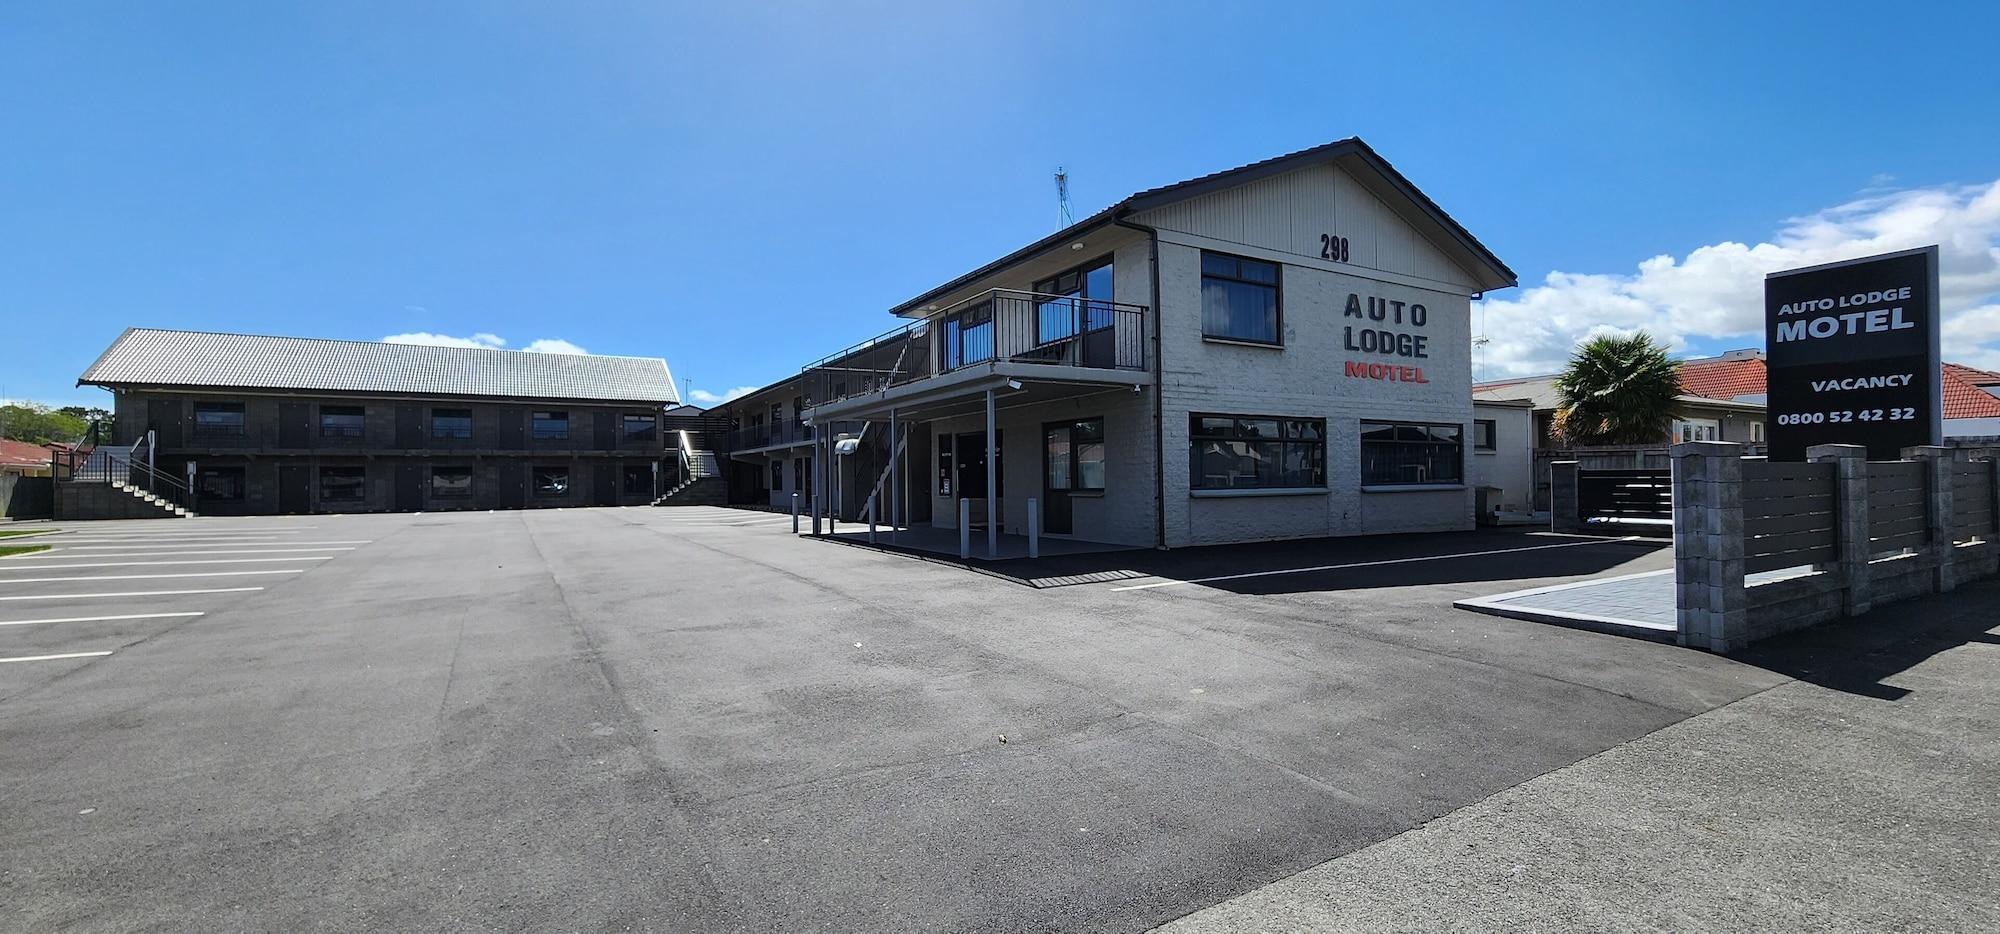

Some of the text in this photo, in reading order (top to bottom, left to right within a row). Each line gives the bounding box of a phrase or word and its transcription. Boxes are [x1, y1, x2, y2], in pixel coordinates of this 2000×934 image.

[1320, 233, 1349, 262] 298
[1344, 293, 1427, 327] AUTO
[1777, 286, 1912, 316] AUTO LODGE
[1776, 307, 1914, 343] MOTEL
[1344, 326, 1428, 358] LODGE
[1344, 360, 1430, 384] MOTEL
[1811, 374, 1913, 392] VACANCY
[1777, 407, 1915, 425] 0800 52 42 32
